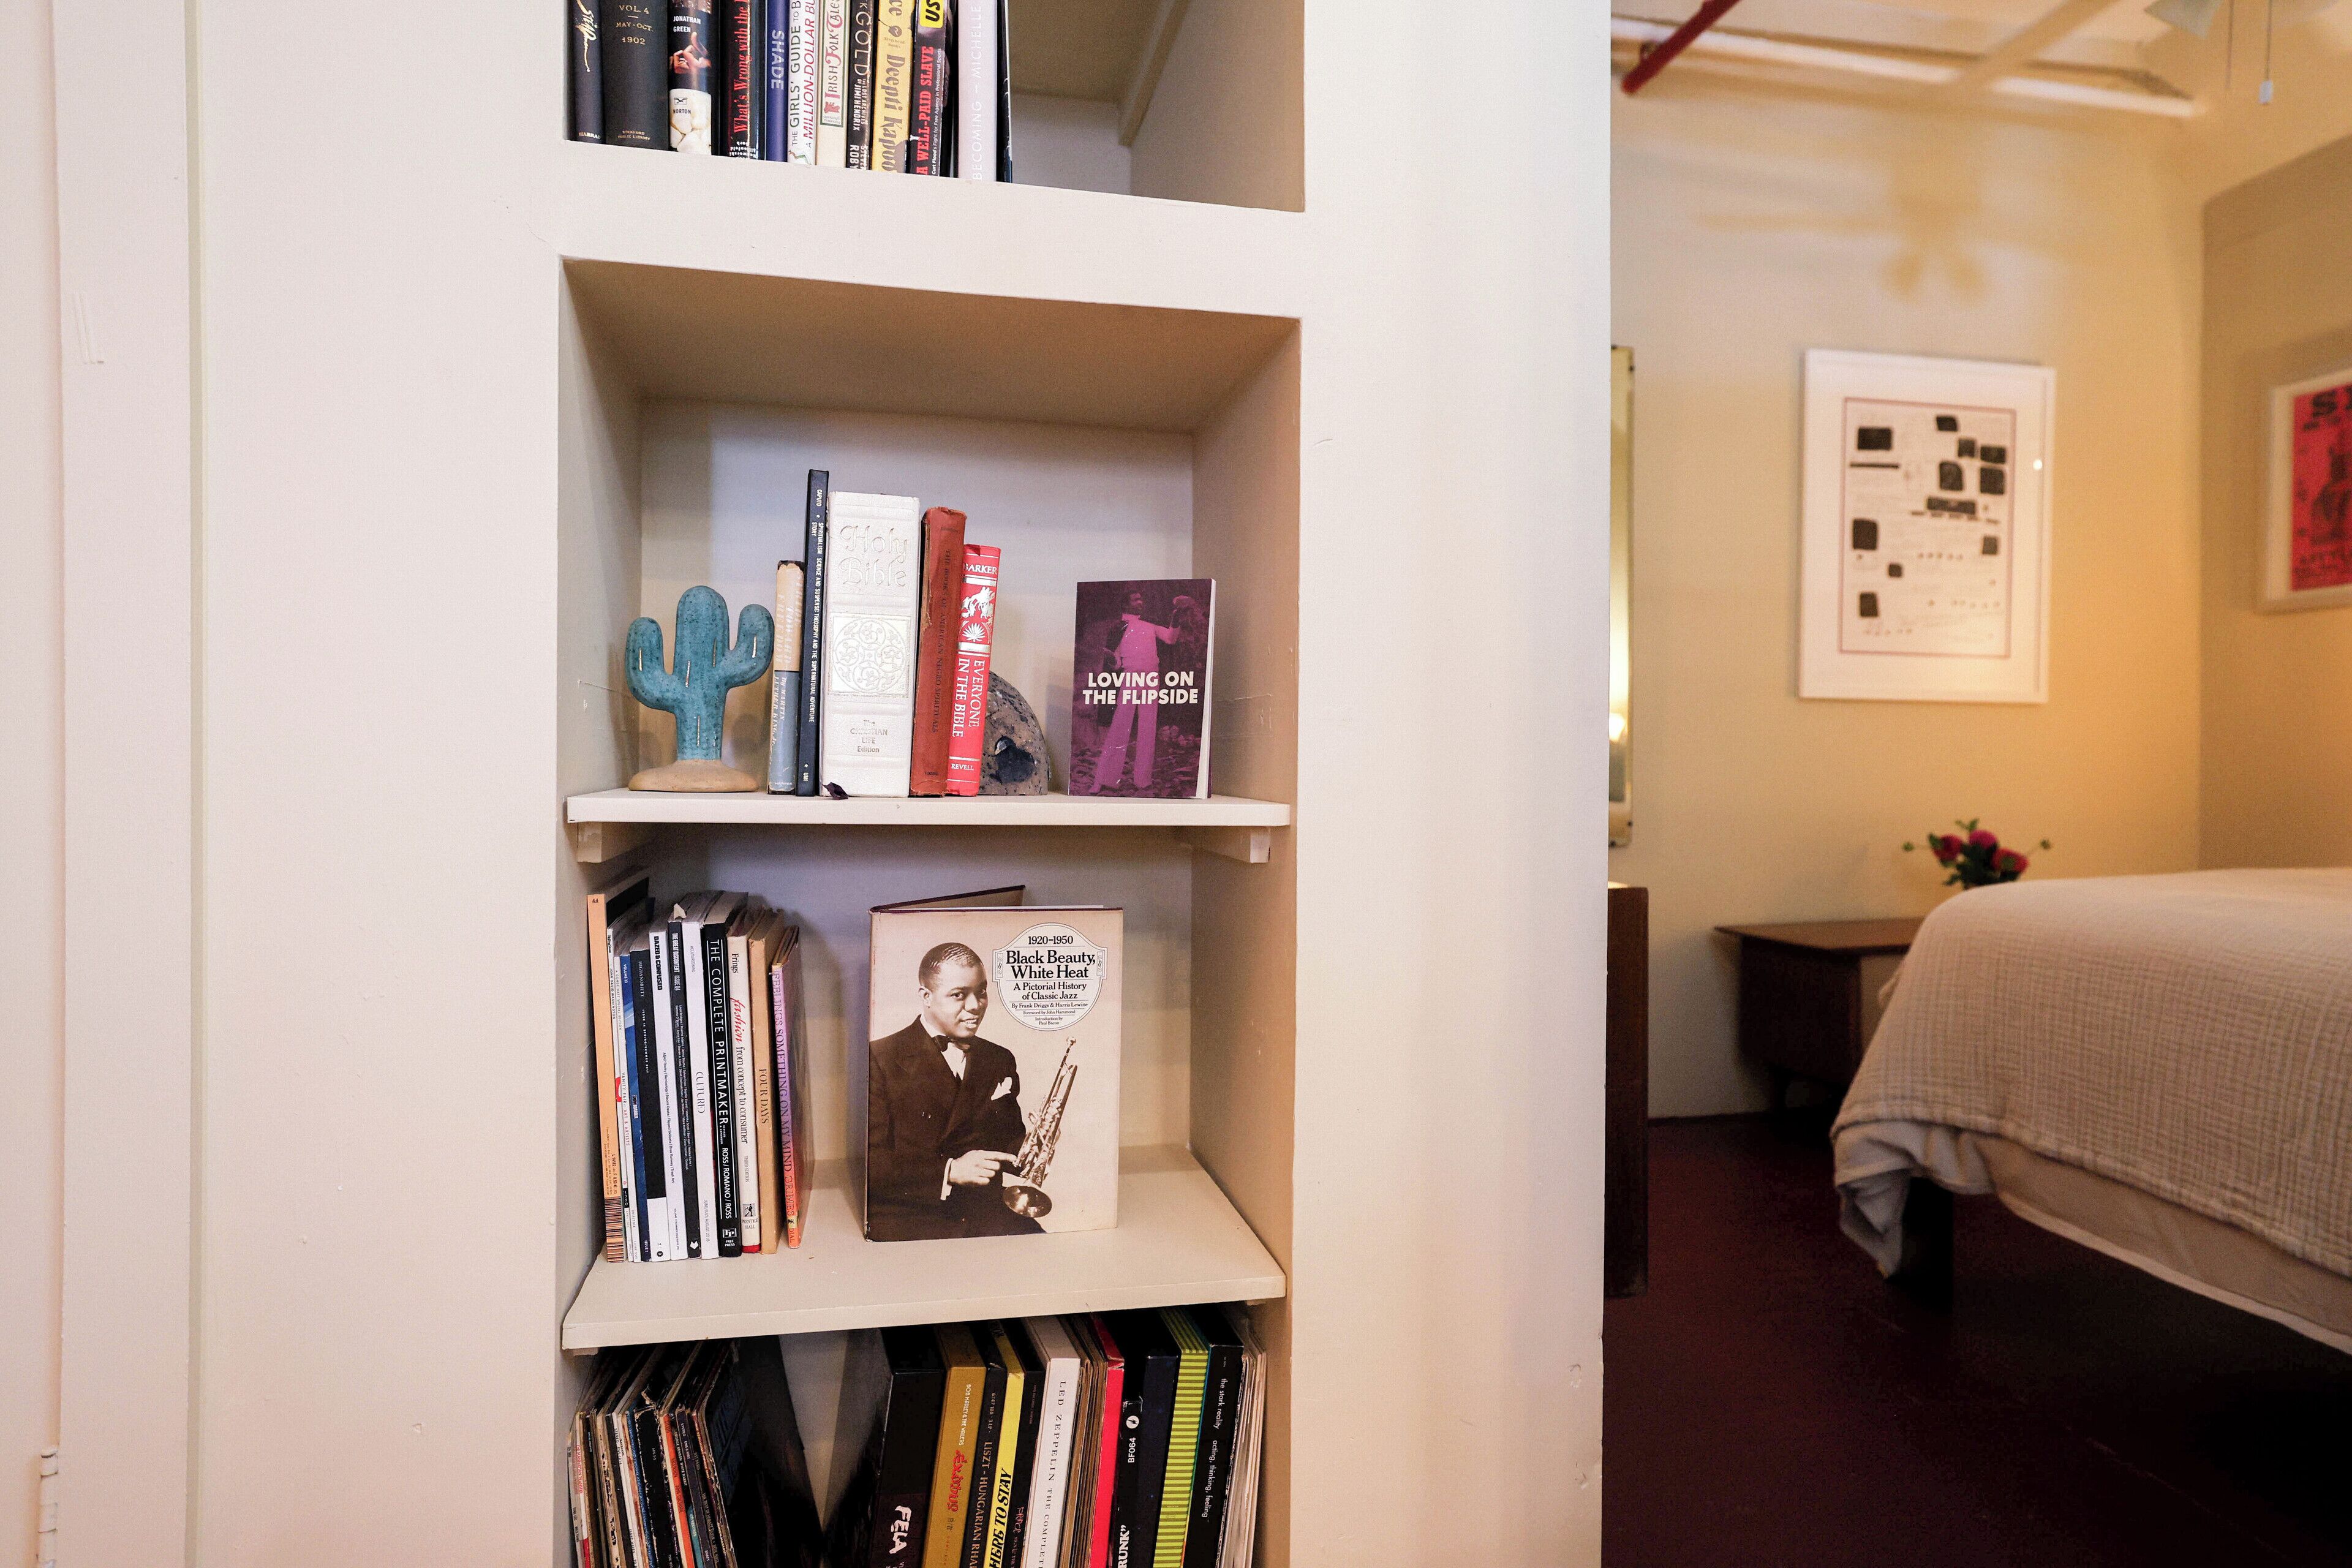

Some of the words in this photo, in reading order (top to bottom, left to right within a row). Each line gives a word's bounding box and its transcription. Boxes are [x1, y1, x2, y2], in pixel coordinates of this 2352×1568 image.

[673, 16, 701, 24] JONATHAN
[734, 6, 748, 24] the
[793, 11, 799, 21] TO
[622, 36, 646, 45] 1902
[734, 28, 748, 51] with
[790, 25, 801, 74] GUIDE
[854, 11, 871, 76] GOLD
[972, 4, 982, 78] MICHELLE
[734, 54, 752, 91] Wrong
[771, 29, 785, 90] SHADE
[920, 46, 935, 86] SLAVE
[803, 18, 815, 140] MILLION-DOLLAR
[854, 84, 862, 98] JIMI
[881, 54, 905, 111] Deepti
[734, 94, 748, 133] What's
[790, 81, 800, 128] GIRLS'
[853, 99, 862, 131] HENDRIX
[917, 90, 932, 161] WELL-PAID
[972, 101, 982, 181] BECOMING
[916, 166, 929, 175] A
[840, 525, 907, 564] Holy
[839, 557, 907, 587] Bible
[958, 658, 970, 673] IN
[1088, 671, 1159, 687] LOVING
[1164, 671, 1194, 687] ON
[956, 676, 968, 701] THE
[968, 660, 985, 727] EVERYONE
[1082, 690, 1117, 704] THE
[1122, 688, 1199, 704] FLIPSIDE
[952, 703, 966, 737] BIBLE
[710, 939, 721, 962] THE
[731, 953, 740, 974] Frings
[1006, 950, 1044, 965] Black
[1047, 950, 1096, 966] Beauty,
[1011, 965, 1054, 979] White
[1057, 964, 1089, 978] Heat
[1023, 982, 1056, 990] Pictorial
[1058, 981, 1087, 991] History
[712, 968, 724, 1033] COMPLETE
[1022, 991, 1031, 1000] of
[1031, 991, 1058, 1000] Classic
[1060, 991, 1078, 1000] Jazz
[728, 997, 747, 1044] fashion
[735, 1046, 745, 1066] from
[774, 1028, 789, 1096] SOMETHING
[696, 1071, 706, 1114] CULTURED
[715, 1041, 729, 1125] PRINTMAKER
[736, 1067, 747, 1096] concept
[759, 1068, 769, 1096] FOUR
[760, 1099, 770, 1124] DAYS
[778, 1100, 790, 1117] ON
[739, 1107, 748, 1144] consumer
[780, 1120, 791, 1137] MY
[782, 1140, 793, 1172] MIND
[785, 1175, 796, 1216] CRIMES
[1057, 1381, 1066, 1406] LED
[1220, 1378, 1229, 1389] the
[962, 1396, 971, 1414] MARLEY
[1213, 1408, 1223, 1430] reality
[981, 1441, 993, 1469] LISZT
[1049, 1414, 1063, 1481] ZEPPELIN
[1128, 1437, 1137, 1464] BF064
[1208, 1439, 1218, 1463] acting,
[997, 1467, 1011, 1507] STAY
[1204, 1464, 1217, 1493] thinking,
[973, 1477, 989, 1541] HUNGARIAN
[994, 1506, 1007, 1527] TO
[1201, 1494, 1213, 1518] feeling
[889, 1505, 912, 1554] FELA
[989, 1528, 1005, 1568] HERE
